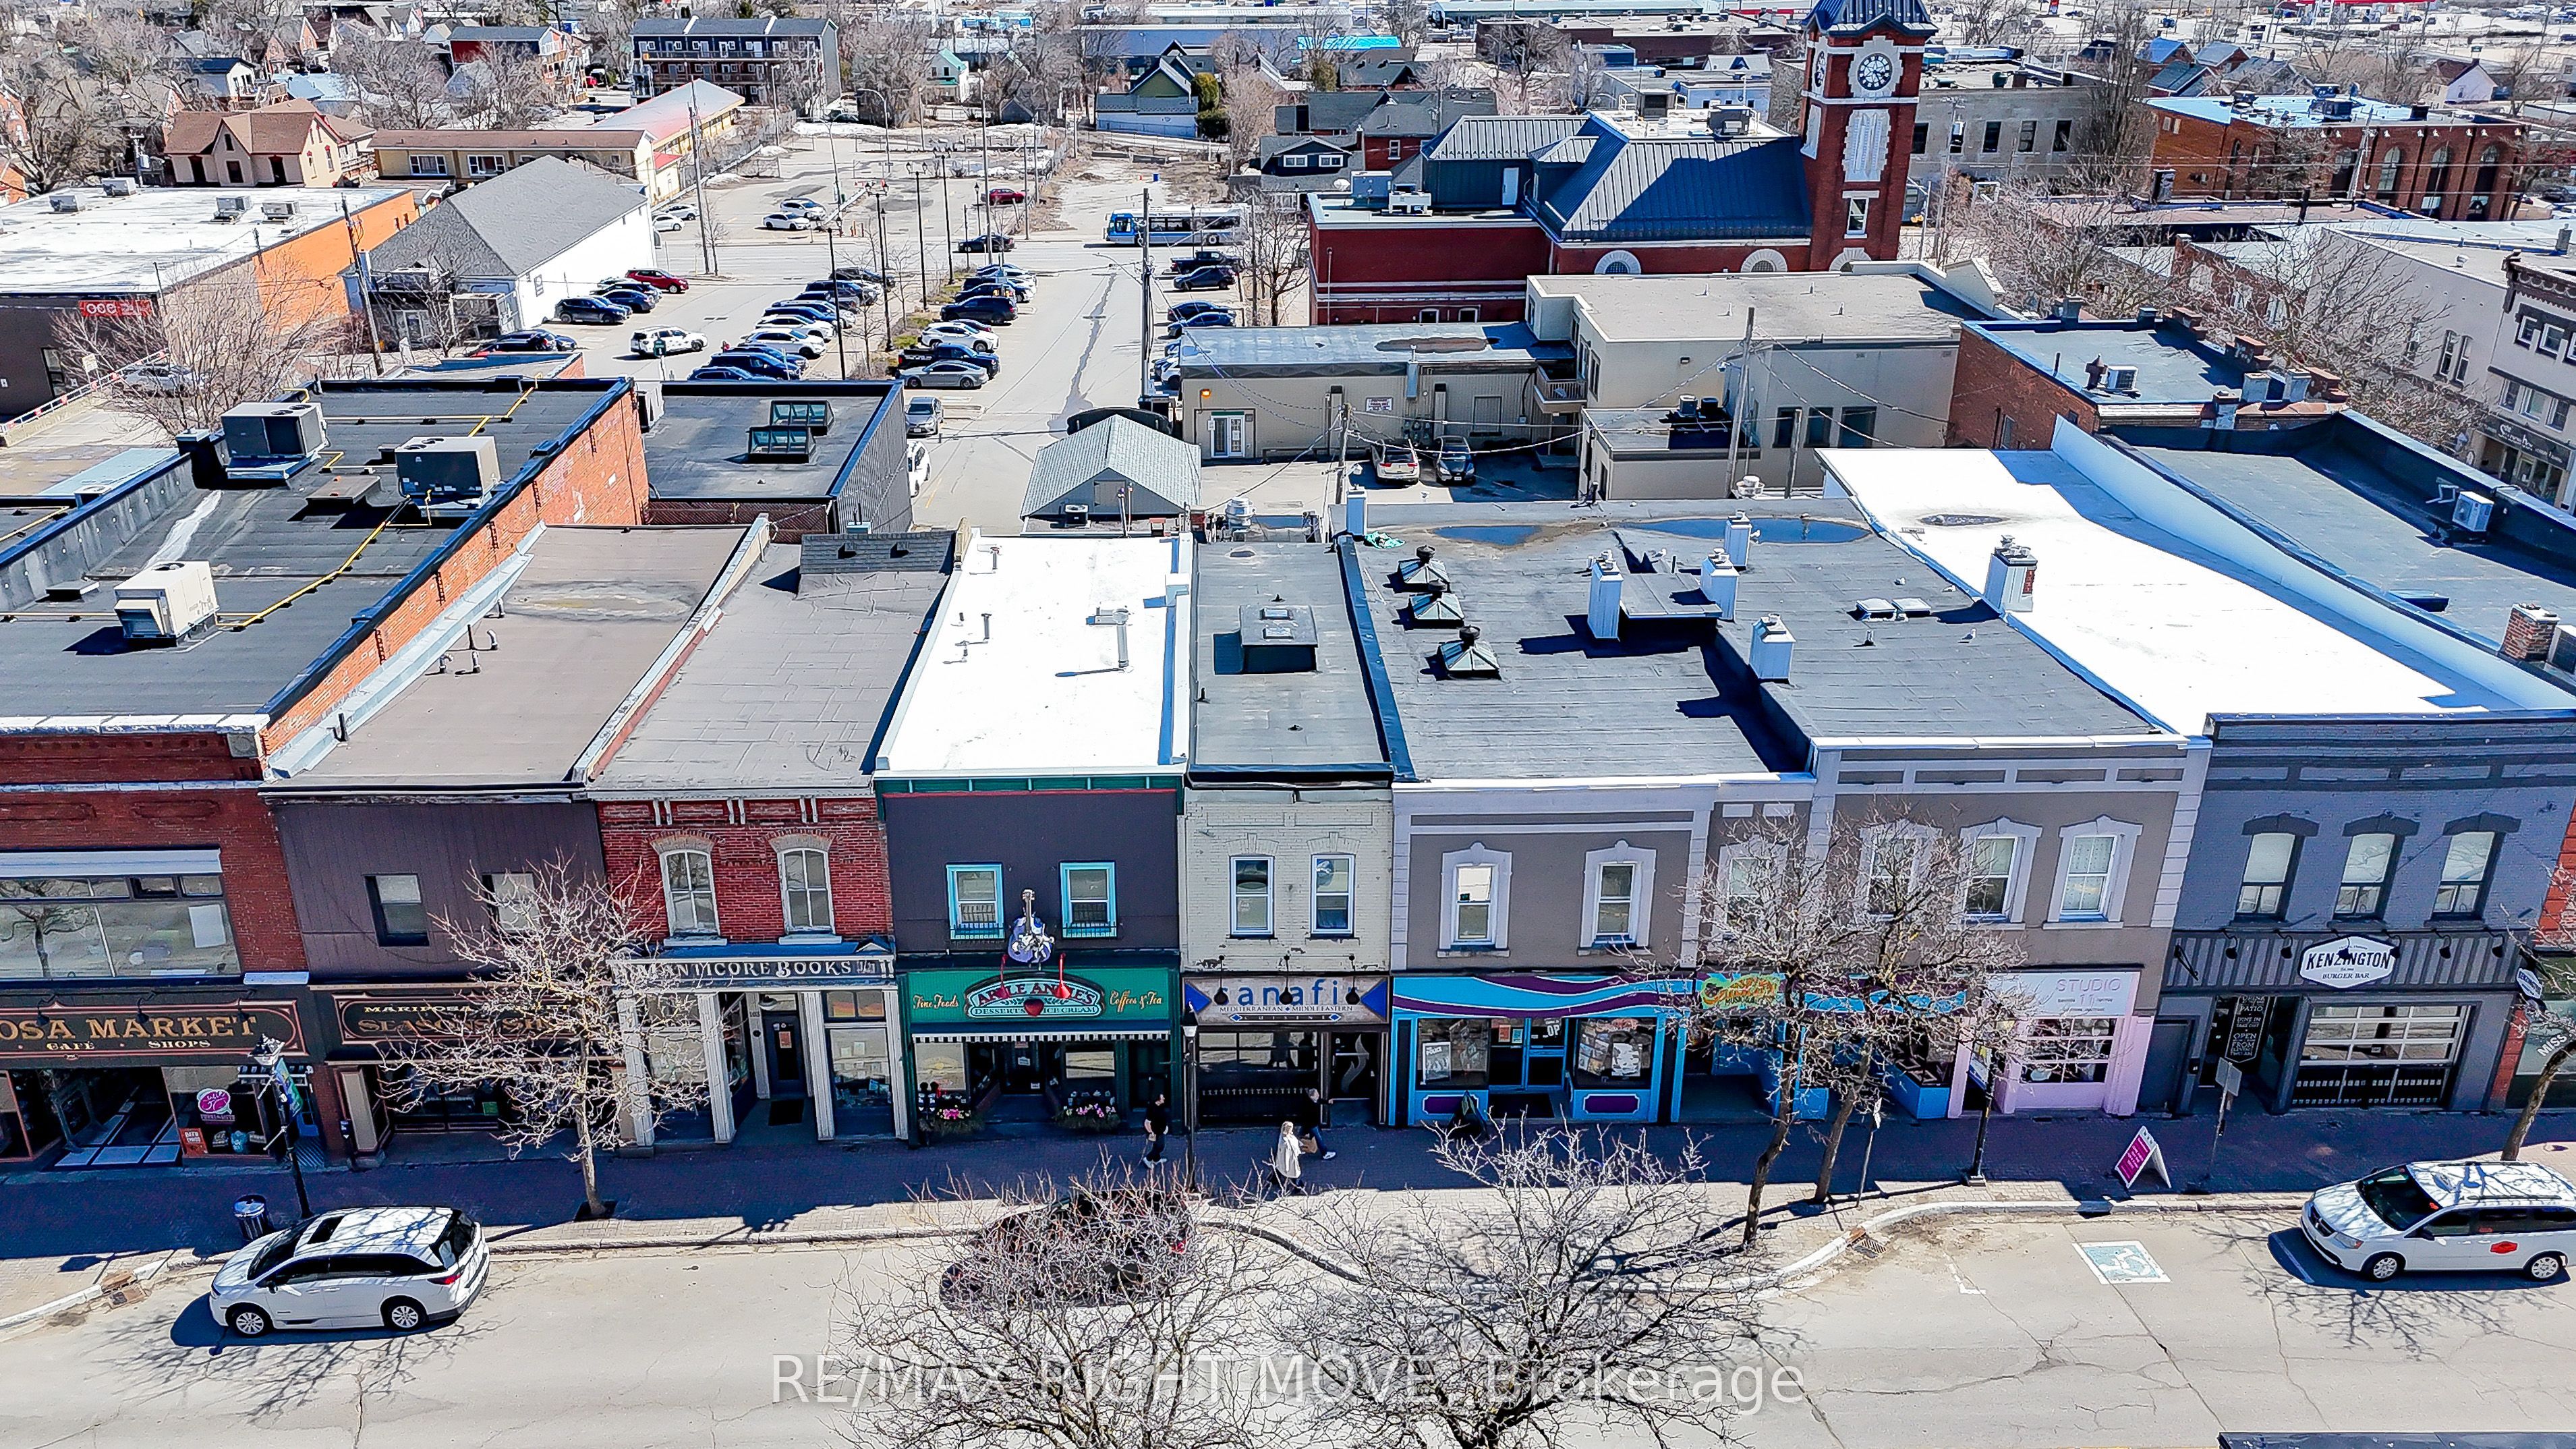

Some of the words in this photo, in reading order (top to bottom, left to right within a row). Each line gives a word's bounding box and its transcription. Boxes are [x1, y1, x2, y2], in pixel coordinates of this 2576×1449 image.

[776, 961, 851, 977] BOOKS
[978, 984, 1027, 1005] APLE
[1031, 982, 1095, 1005] ANIE'S
[2057, 978, 2121, 992] STUDIO
[913, 994, 933, 1009] Fine
[934, 994, 958, 1009] Foods
[1110, 990, 1137, 1013] Coffees
[1147, 992, 1162, 1005] Tea
[0, 1019, 76, 1040] OSA
[86, 1016, 257, 1039] MARKET
[46, 1040, 95, 1051] CAFÉ
[148, 1040, 211, 1049] SHOPS
[2537, 1034, 2567, 1056] MISS
